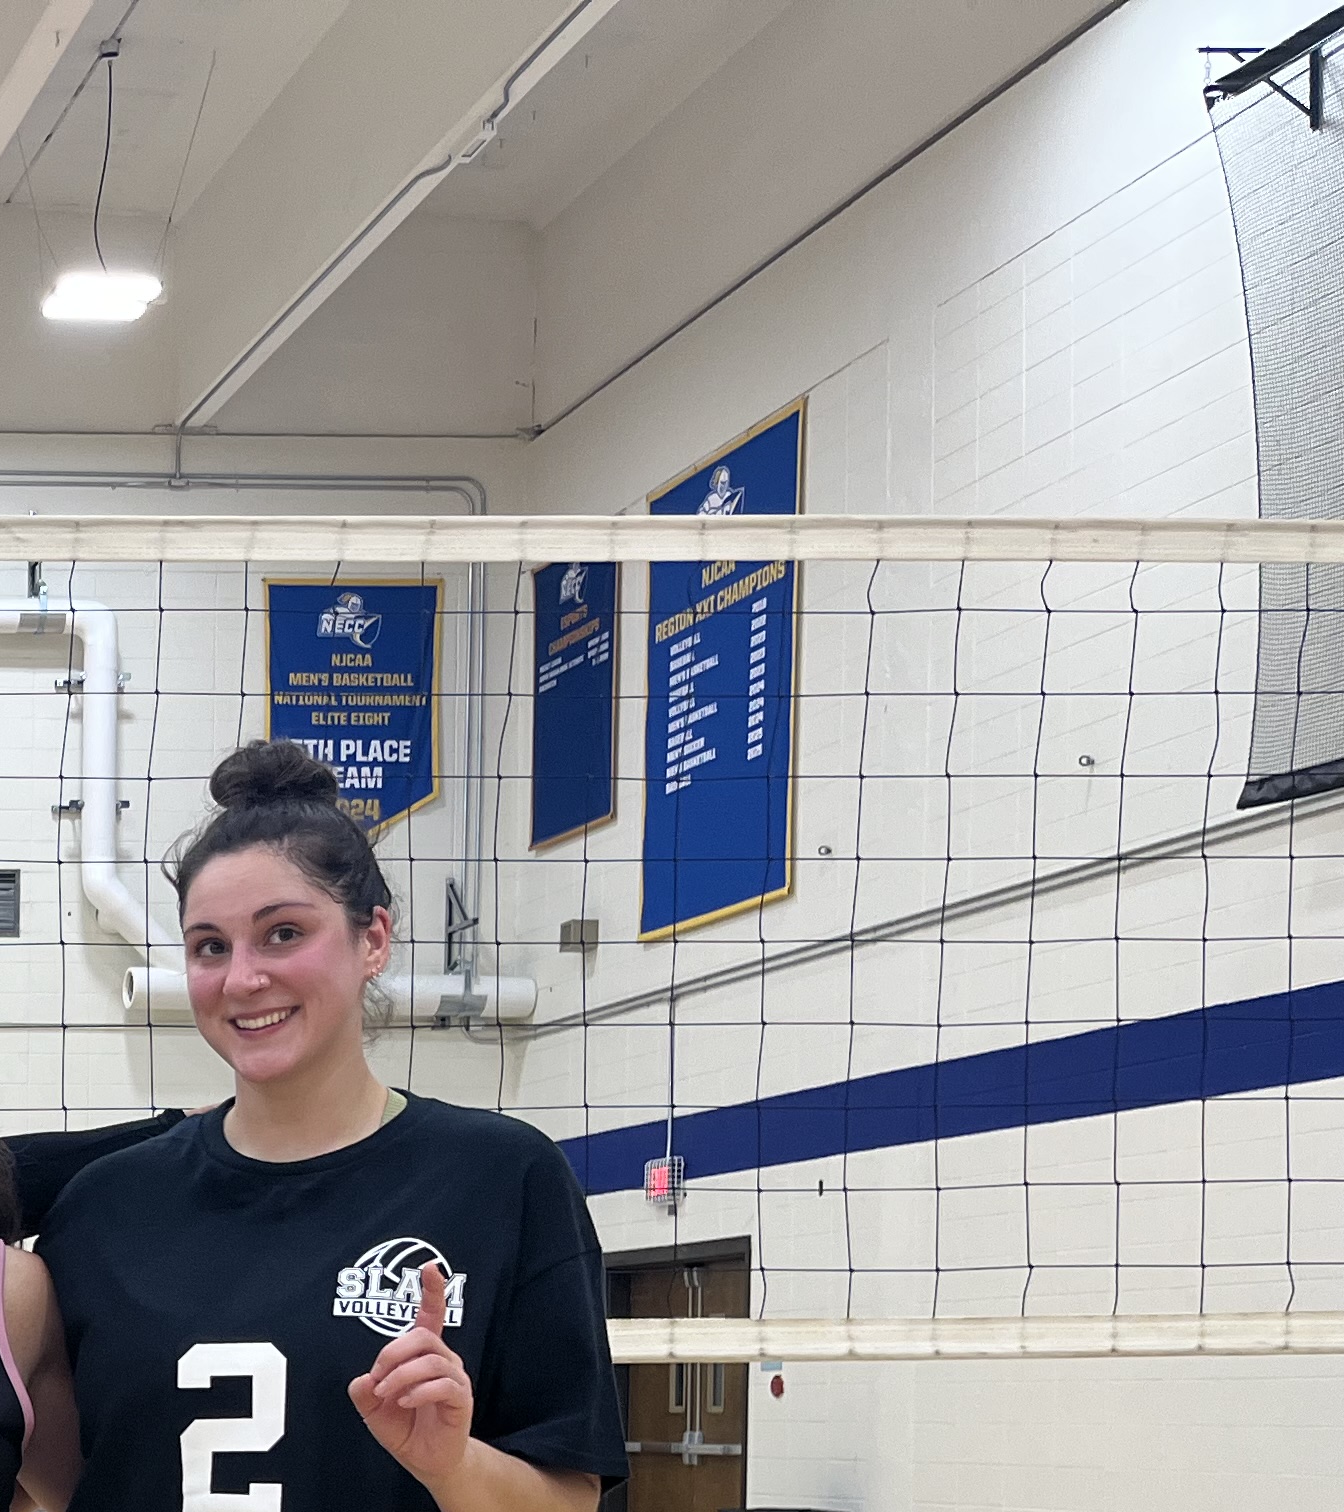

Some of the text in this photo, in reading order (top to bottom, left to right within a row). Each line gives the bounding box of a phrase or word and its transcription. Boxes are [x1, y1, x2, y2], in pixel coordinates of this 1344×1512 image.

[654, 607, 694, 644] REGION
[717, 560, 786, 613] CHAMPIONS
[321, 618, 365, 634] NECC
[331, 653, 372, 667] NJCAA
[288, 672, 414, 687] MEN'S BASKETBALL
[274, 691, 427, 707] NATIONAL TOURNAMENT
[311, 711, 392, 726] ELITE EIGHT
[290, 738, 411, 763] TH PLACE
[332, 766, 383, 789] EAM
